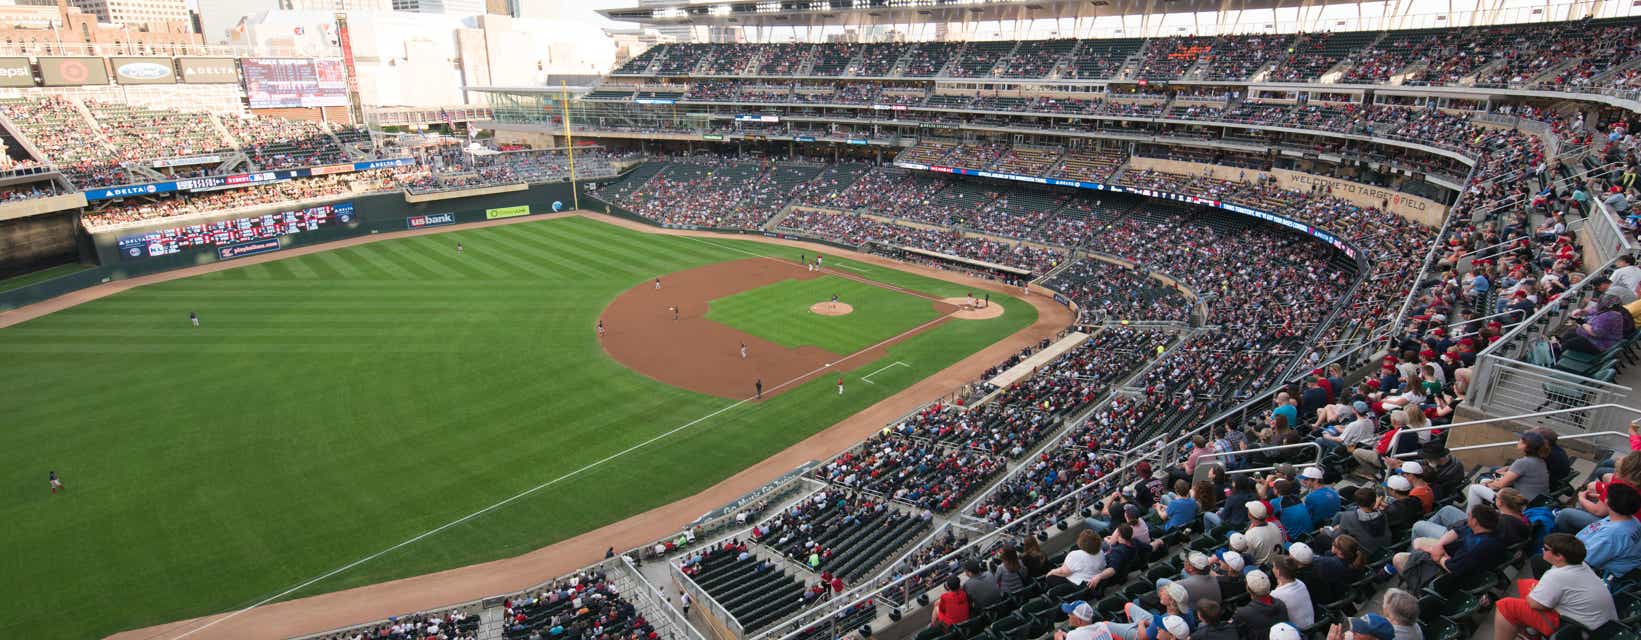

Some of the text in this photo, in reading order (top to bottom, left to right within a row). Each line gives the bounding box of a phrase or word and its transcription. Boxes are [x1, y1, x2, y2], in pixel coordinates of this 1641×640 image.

[197, 66, 236, 74] DELTA
[113, 186, 145, 195] DELTA
[1291, 175, 1426, 210] WELCOME TO TARGET FIELD
[723, 506, 737, 514] Go
[762, 484, 774, 493] Go
